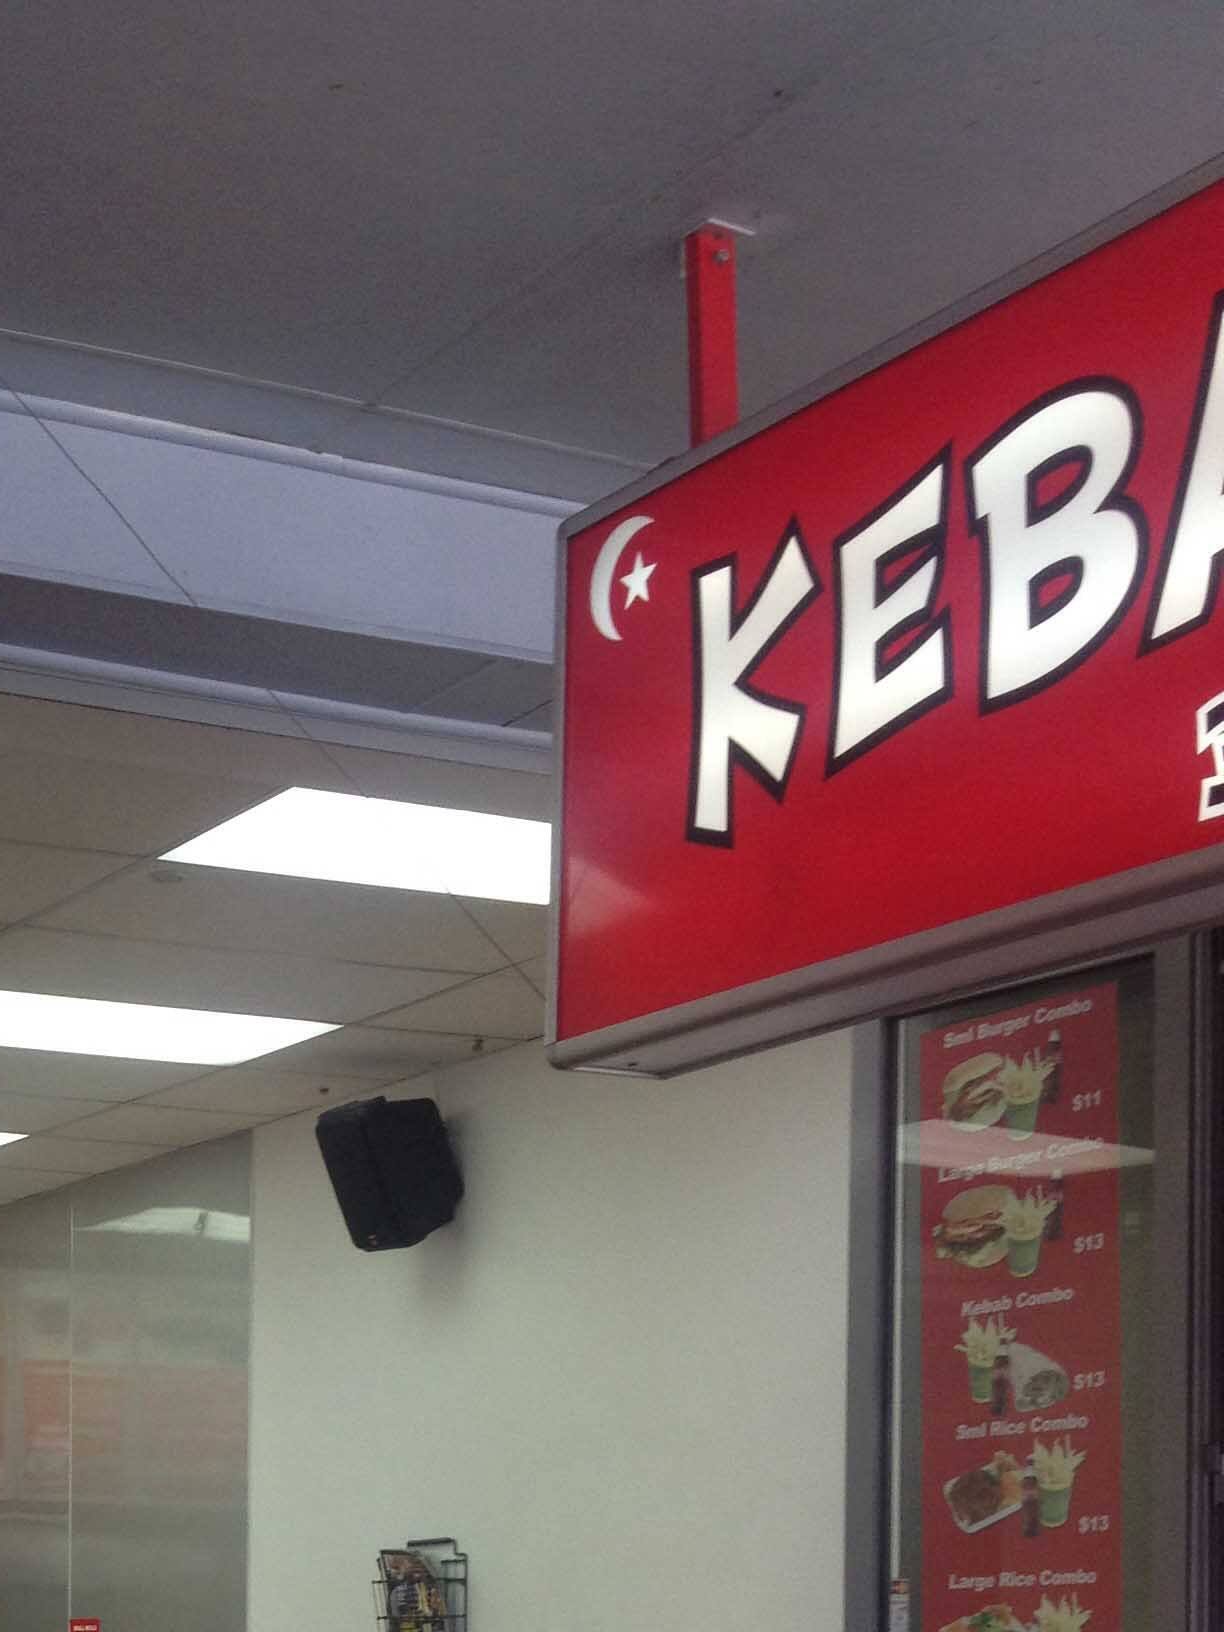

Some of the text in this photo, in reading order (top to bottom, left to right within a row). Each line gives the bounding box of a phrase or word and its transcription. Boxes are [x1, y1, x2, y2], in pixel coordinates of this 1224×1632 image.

[977, 1015, 1030, 1040] Burger
[1034, 1000, 1093, 1025] Combo
[1072, 1089, 1102, 1112] $11
[937, 1161, 985, 1184] Large
[1074, 1233, 1105, 1254] $13
[961, 1288, 1073, 1318] Kebab Combo
[1073, 1371, 1105, 1391] $13
[990, 1418, 1025, 1437] Rice
[1031, 1413, 1089, 1434] Combo
[1078, 1515, 1109, 1534] $13
[948, 1569, 1097, 1592] Large Rice Combo
